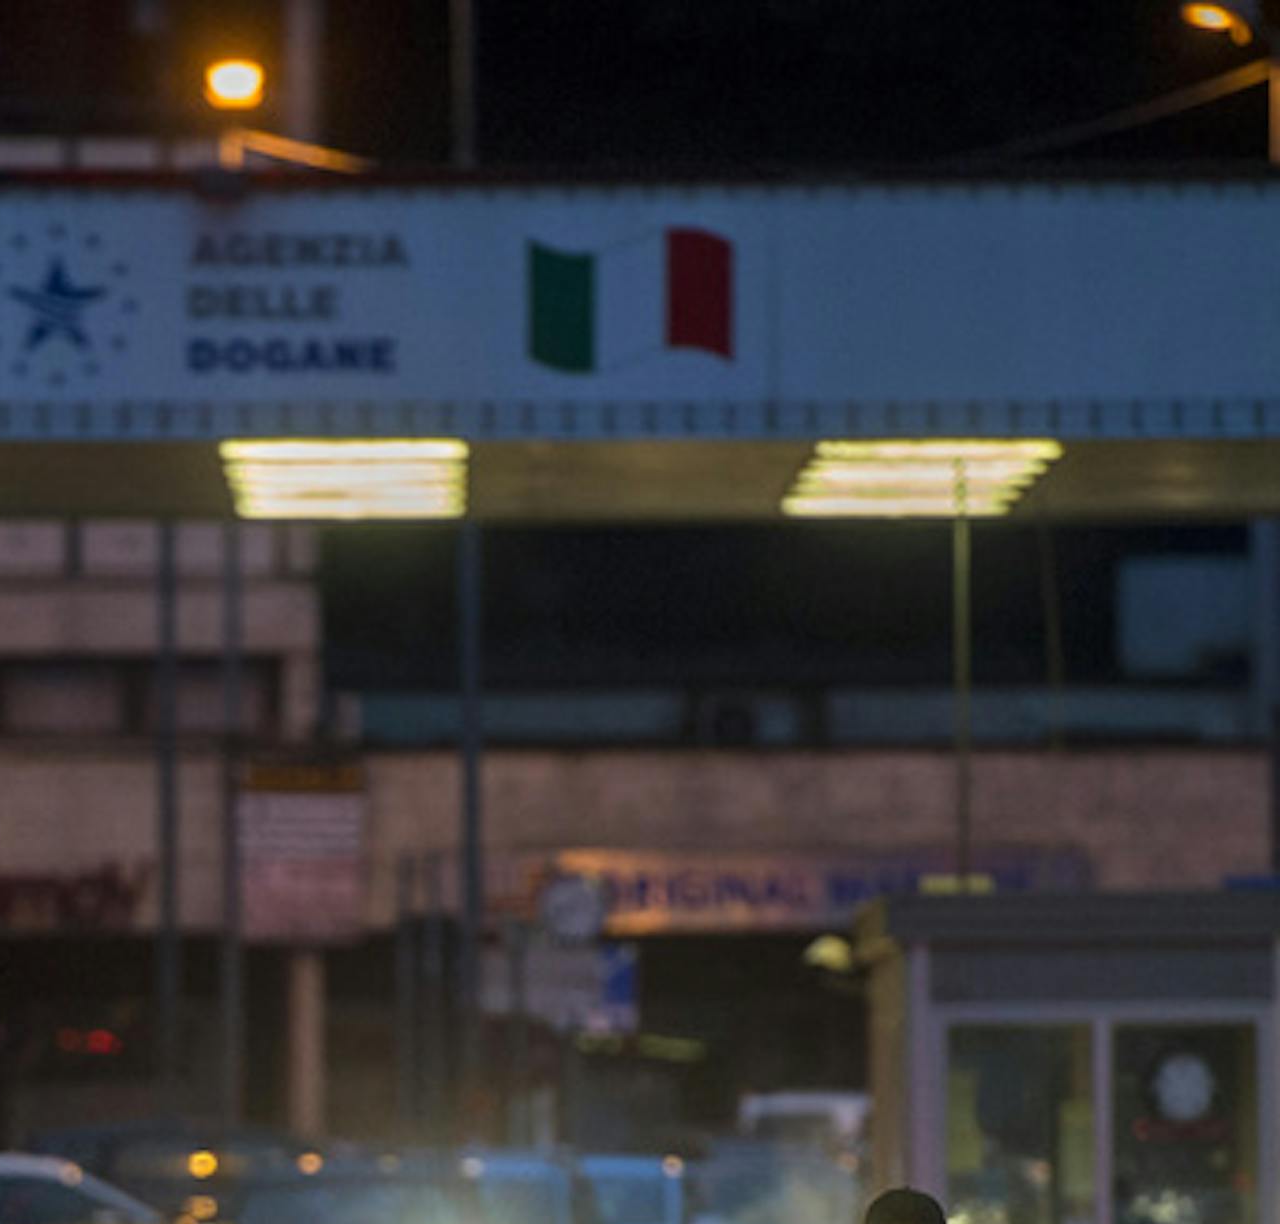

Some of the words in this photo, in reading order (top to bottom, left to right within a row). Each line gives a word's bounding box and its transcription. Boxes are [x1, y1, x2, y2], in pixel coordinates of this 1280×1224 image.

[190, 233, 409, 268] AGENZIA
[188, 285, 338, 320] DELLE
[187, 336, 397, 374] DOGANE
